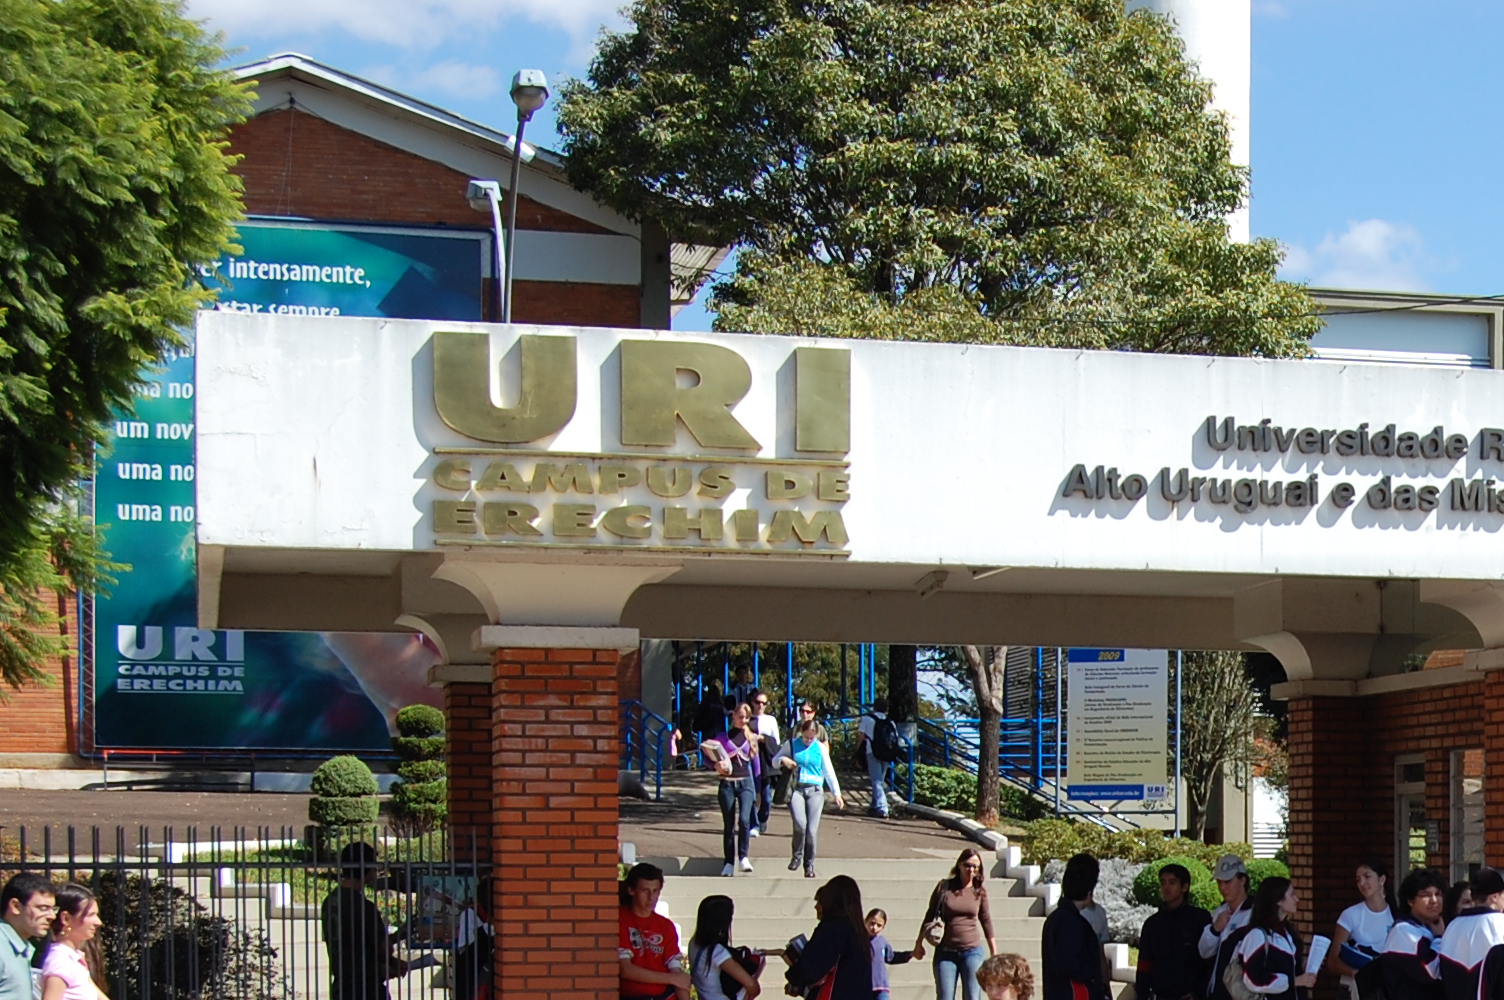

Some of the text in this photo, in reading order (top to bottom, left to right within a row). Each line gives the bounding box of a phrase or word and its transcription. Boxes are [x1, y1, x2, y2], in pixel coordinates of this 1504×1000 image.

[229, 257, 371, 288] intensamente,
[432, 331, 851, 454] URI
[116, 420, 149, 439] um
[1206, 415, 1468, 460] Universidade
[117, 462, 163, 481] uma
[433, 459, 851, 501] CAMPUS DE
[1062, 463, 1149, 501] Alto
[1160, 466, 1319, 514] Uruguai
[1332, 481, 1356, 508] e
[1367, 475, 1440, 512] das
[117, 503, 163, 522] uma
[433, 500, 849, 544] ERECHIM
[117, 624, 245, 662] URI
[117, 678, 244, 691] ERECHIM
[118, 664, 245, 677] CAMPUS DE
